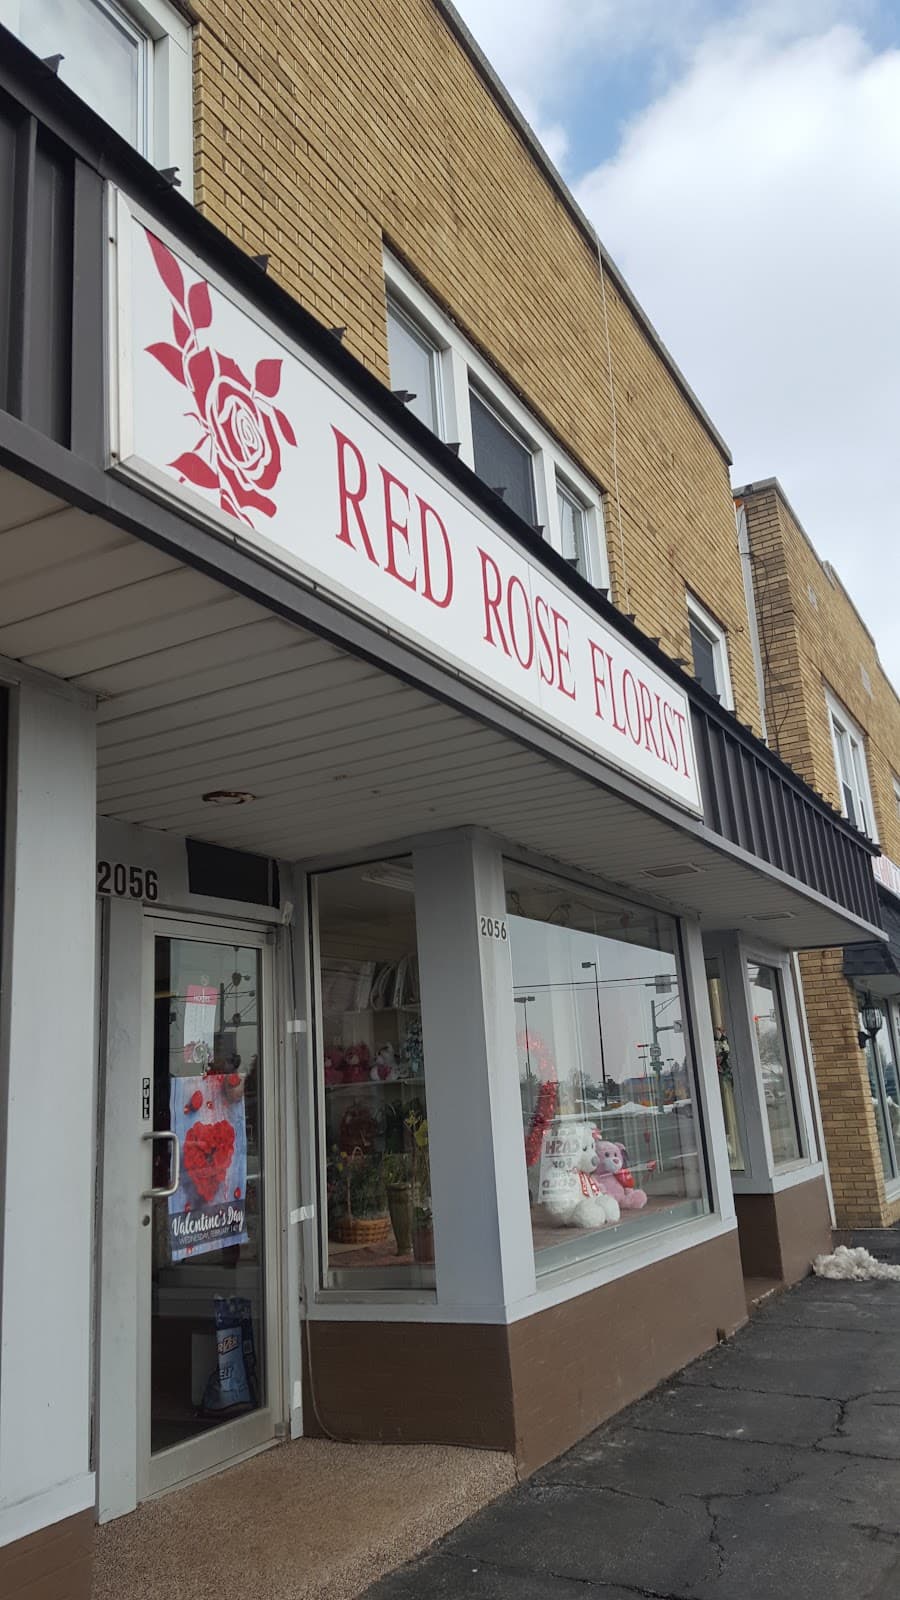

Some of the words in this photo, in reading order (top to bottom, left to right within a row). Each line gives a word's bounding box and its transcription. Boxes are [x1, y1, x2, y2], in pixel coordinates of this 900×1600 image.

[331, 425, 454, 610] RED
[476, 546, 577, 700] ROSE
[588, 638, 691, 778] FLORIST
[97, 861, 158, 901] 2056
[480, 916, 507, 941] 2056
[171, 1209, 226, 1237] Valentine's
[226, 1206, 245, 1233] Day
